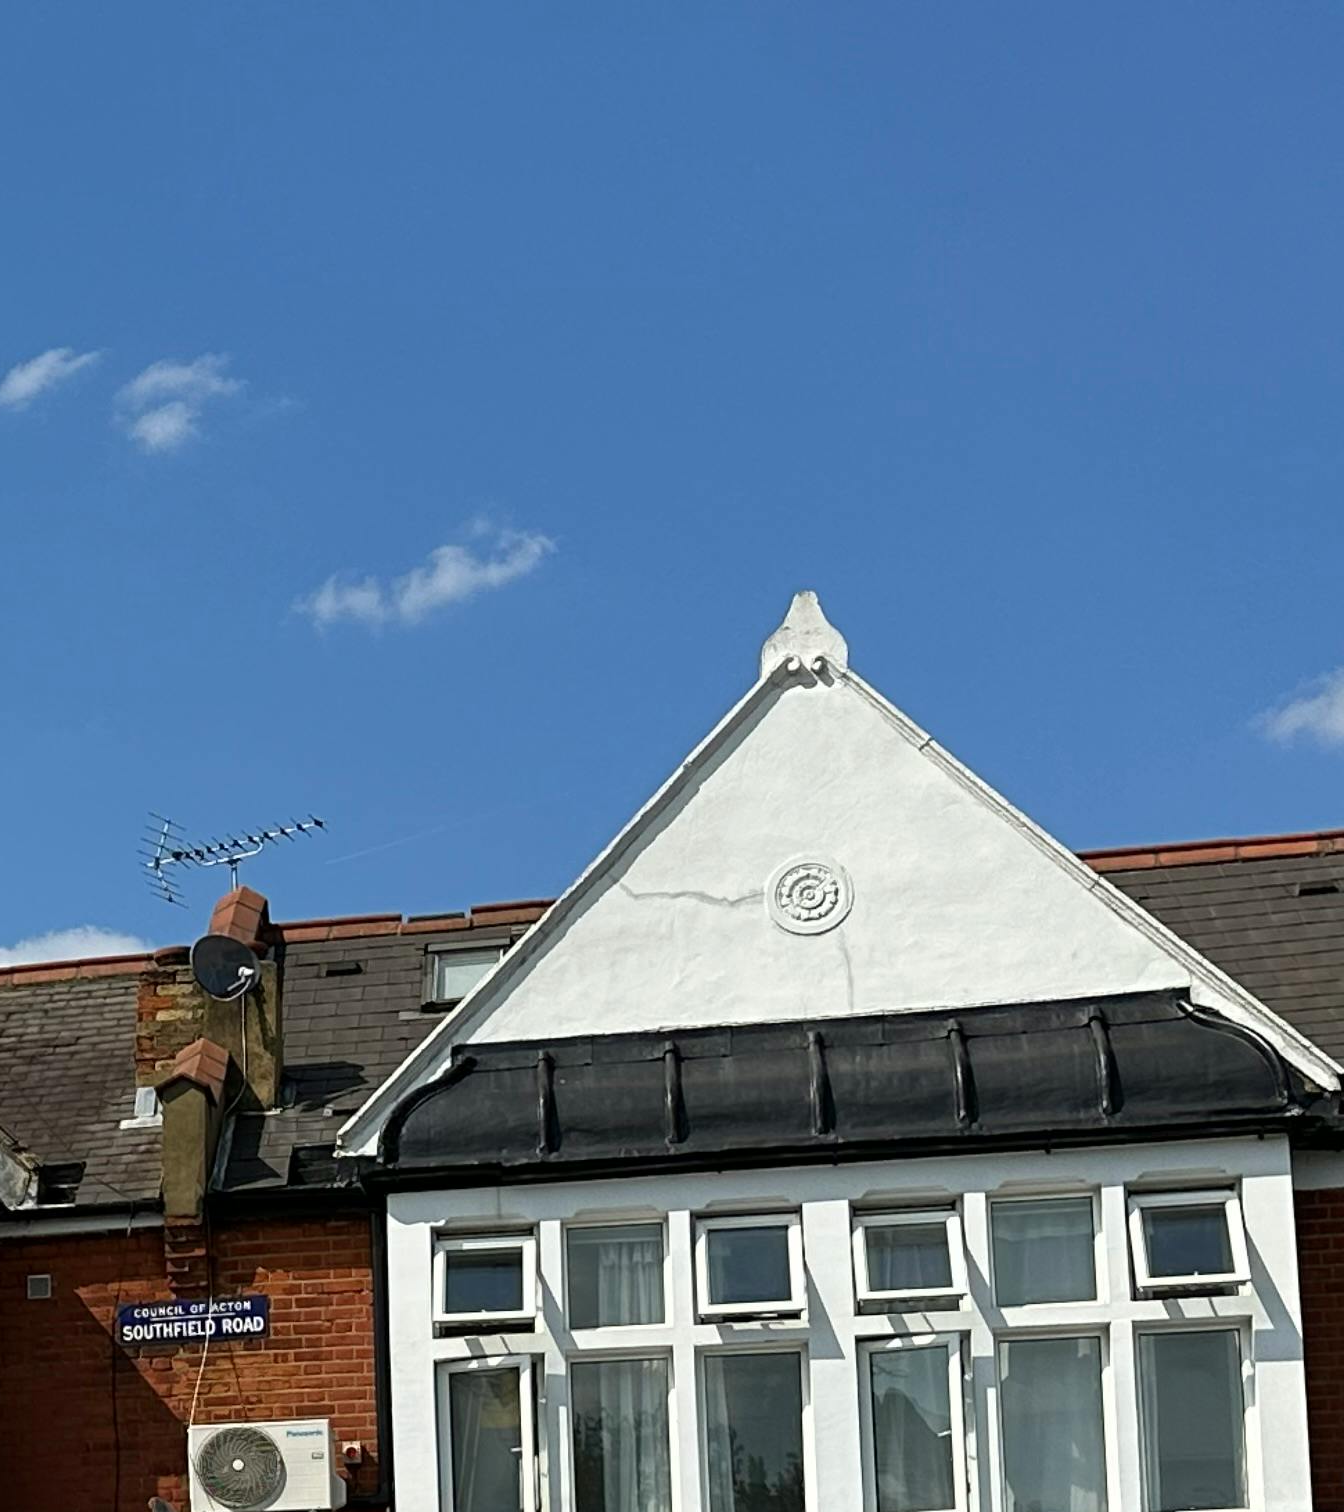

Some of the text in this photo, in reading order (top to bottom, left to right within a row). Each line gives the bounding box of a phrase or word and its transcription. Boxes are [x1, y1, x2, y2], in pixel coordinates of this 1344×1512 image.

[133, 1301, 252, 1319] COUNCIL OF ACTON
[122, 1316, 265, 1341] SOUTHFIELD ROAD
